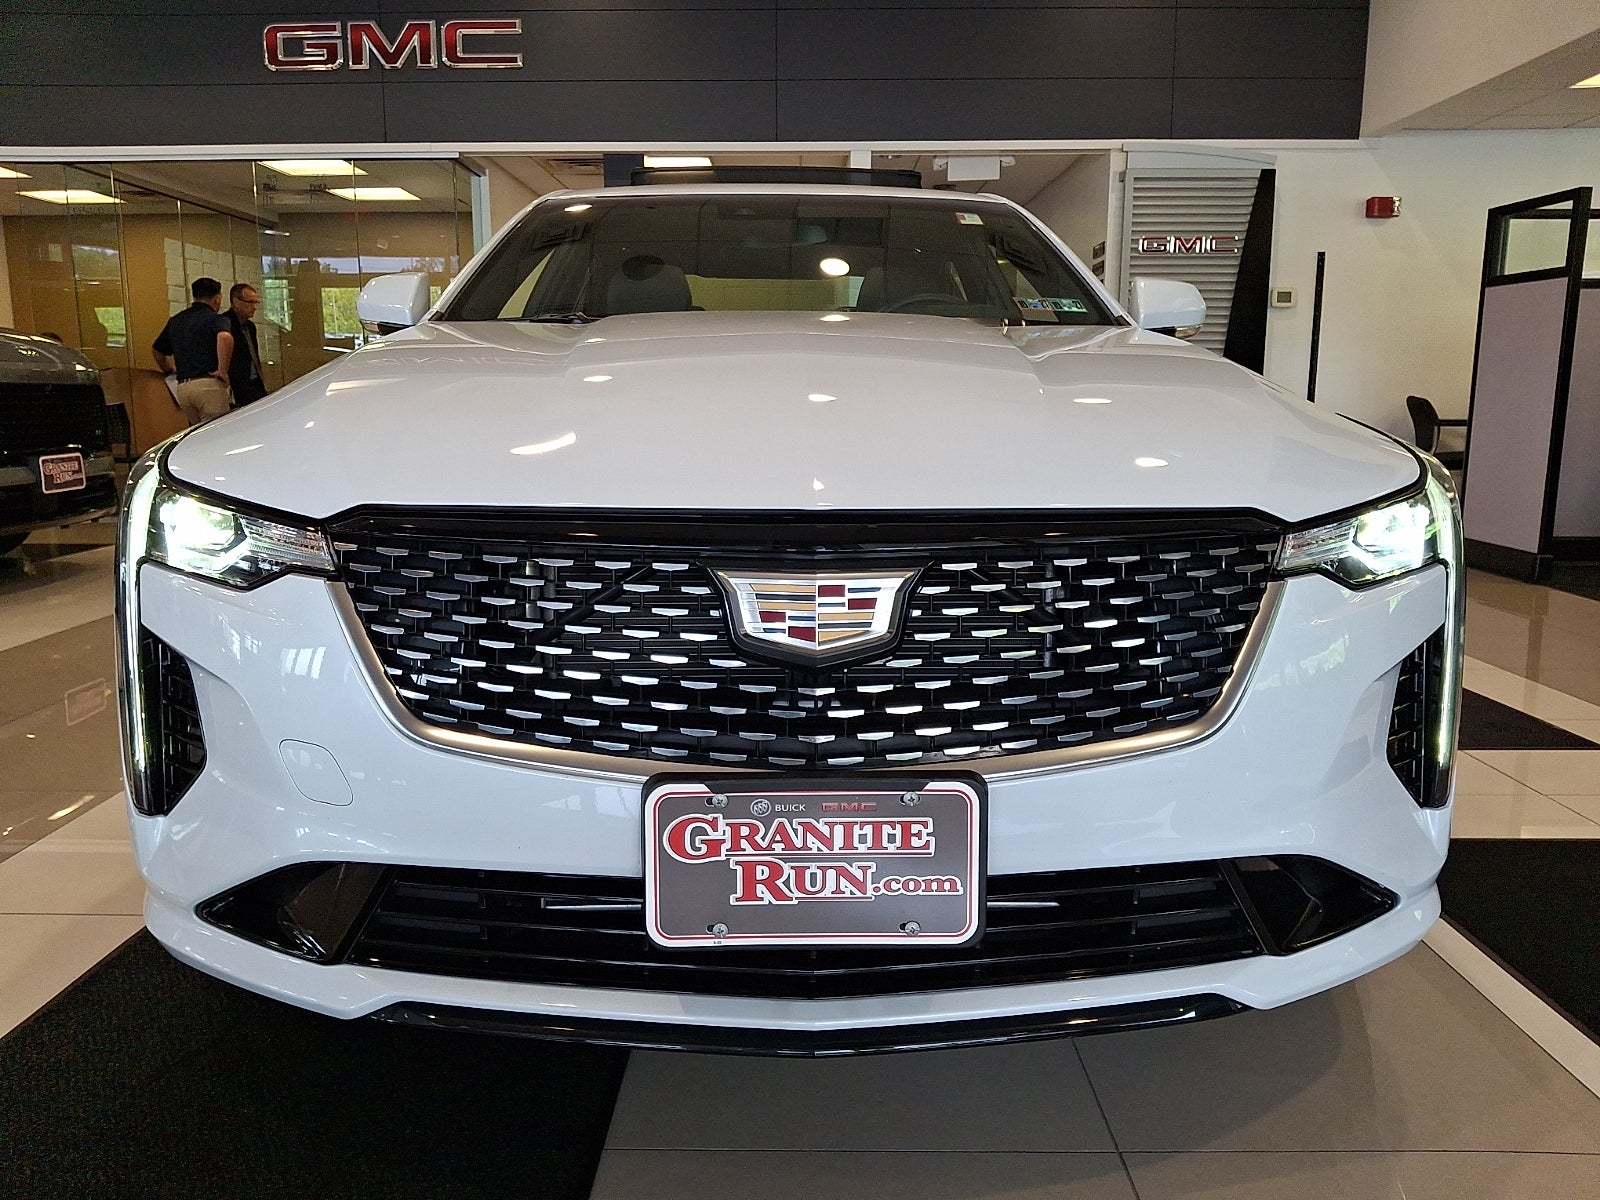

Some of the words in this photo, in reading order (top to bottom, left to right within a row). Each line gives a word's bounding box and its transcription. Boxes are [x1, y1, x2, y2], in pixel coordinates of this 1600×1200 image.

[263, 19, 523, 71] GMC
[1138, 235, 1239, 254] GMC
[775, 803, 806, 812] BUICK
[821, 801, 878, 812] GMC
[664, 815, 935, 861] GRANITE
